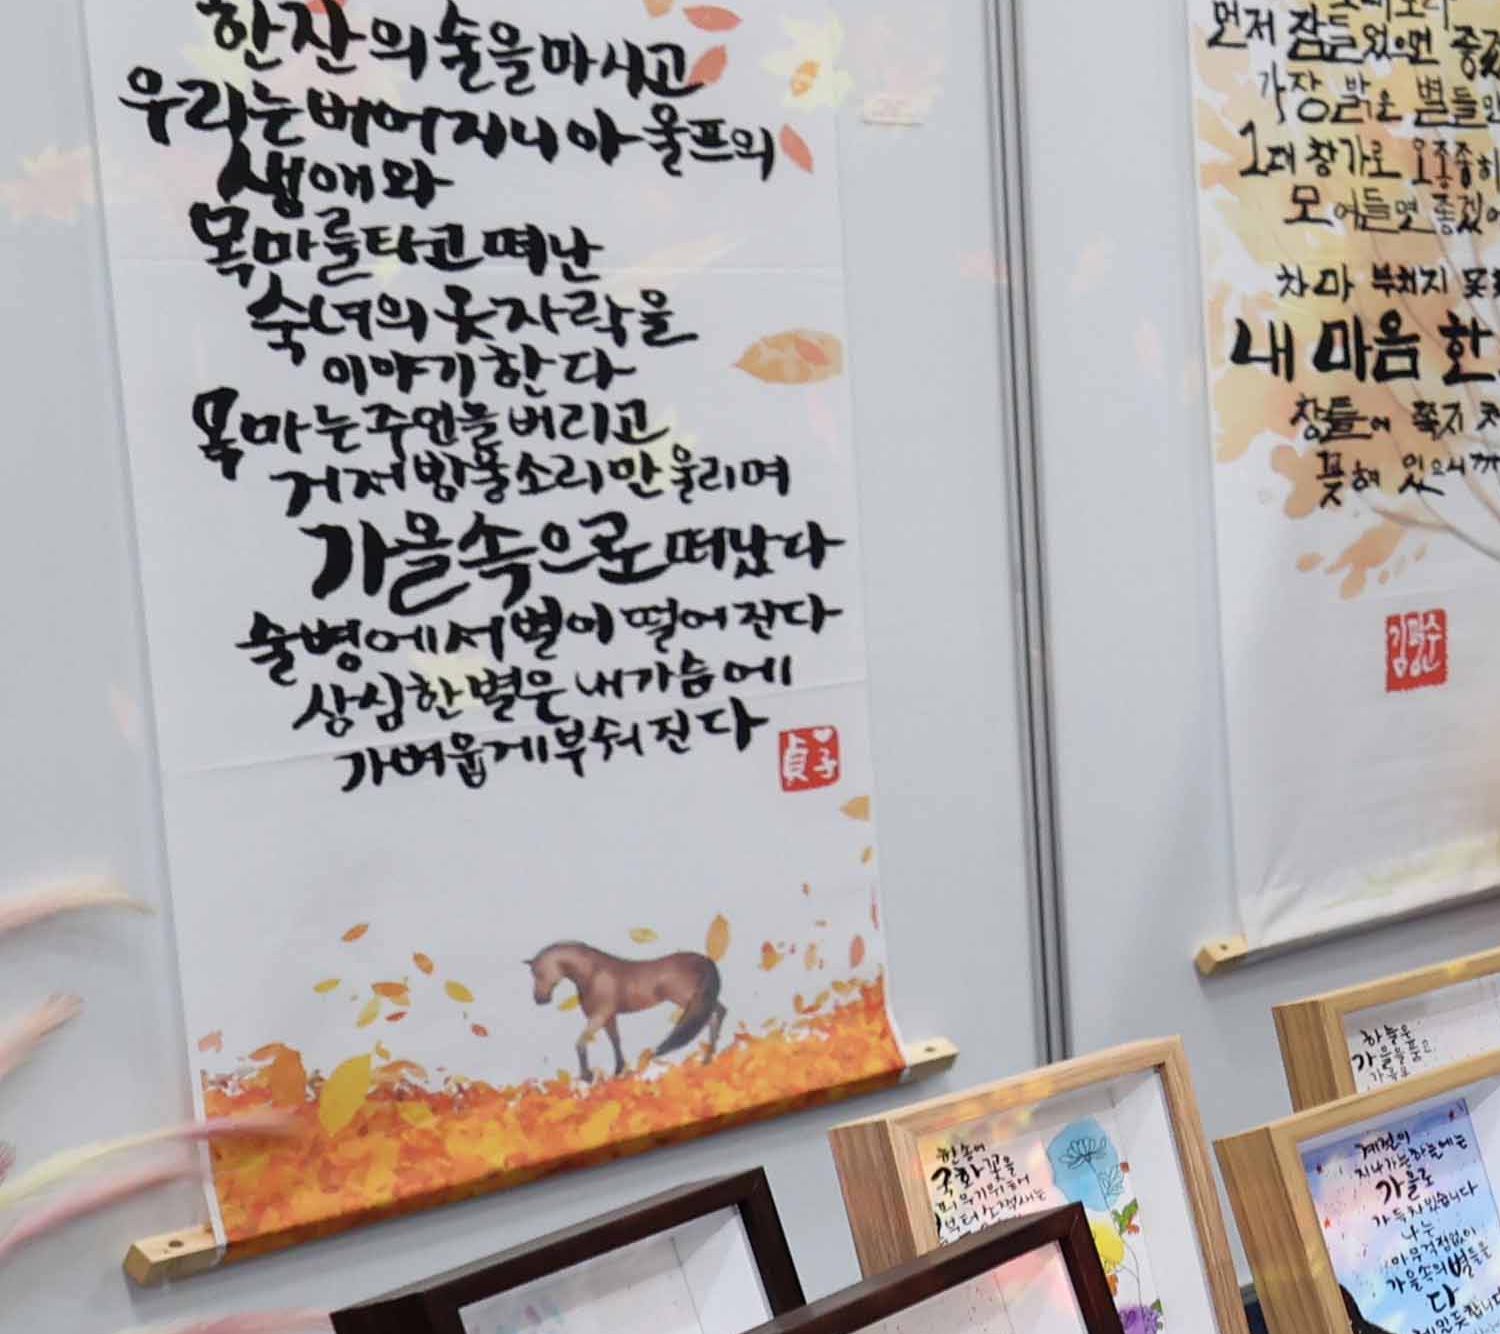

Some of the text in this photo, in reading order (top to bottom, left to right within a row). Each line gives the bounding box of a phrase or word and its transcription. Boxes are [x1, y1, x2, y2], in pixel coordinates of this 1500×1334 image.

[433, 0, 533, 93] 술을
[539, 34, 705, 96] 마시고
[1207, 0, 1277, 48] 먼저
[1287, 4, 1440, 65] 잠들었으면
[119, 65, 302, 146] 우리는
[642, 103, 775, 179] 울프의
[1260, 62, 1330, 124] 가장
[1332, 74, 1402, 124] 밝은
[217, 146, 453, 217] 생애와
[1305, 137, 1402, 177] 창가로
[191, 203, 372, 285] 목마를
[364, 221, 483, 274] 타고
[1276, 264, 1354, 300] 차마
[1371, 266, 1447, 297] 부치지
[247, 271, 697, 365] 숙녀의 옷자락을
[1230, 317, 1294, 382] 내
[1313, 310, 1420, 383] 마음
[1439, 311, 1496, 384] 한
[192, 388, 670, 479] 목마는 주인을 버리고
[670, 444, 791, 502] 울리며
[666, 522, 845, 578] 떠났다
[236, 594, 842, 686] 술병에서 별이 떨어진다
[294, 675, 466, 736] 상심한
[472, 671, 566, 725] 별은
[631, 651, 792, 692] 가슴에
[1360, 1130, 1411, 1160] 계절이
[1376, 1171, 1435, 1205] 가을로
[1402, 1221, 1436, 1242] 나는
[1426, 1286, 1460, 1314] 다
